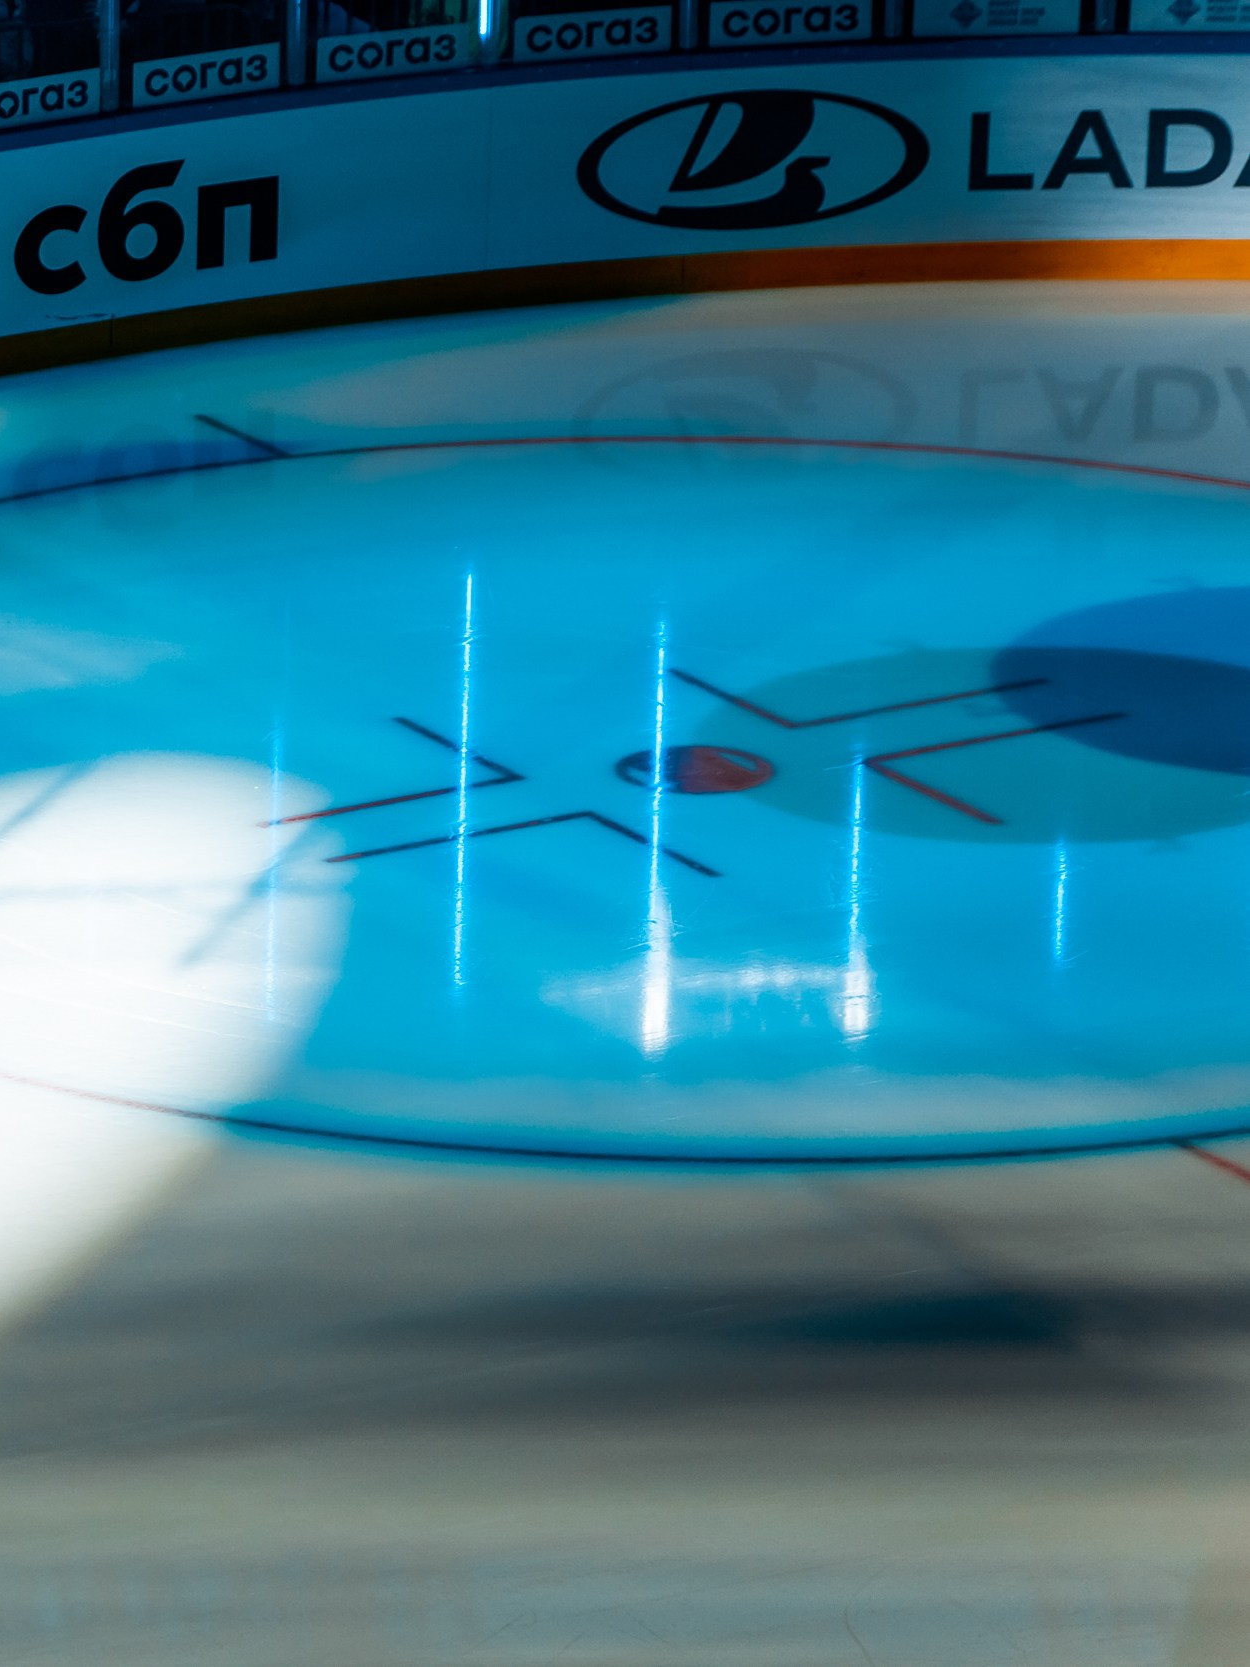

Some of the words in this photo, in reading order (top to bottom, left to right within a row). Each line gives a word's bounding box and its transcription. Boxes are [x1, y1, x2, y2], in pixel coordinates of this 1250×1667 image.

[526, 15, 659, 53] согаз
[722, 0, 859, 40] согаз
[327, 33, 457, 73] согаз
[144, 53, 268, 97] согаз
[13, 158, 280, 296] сбп
